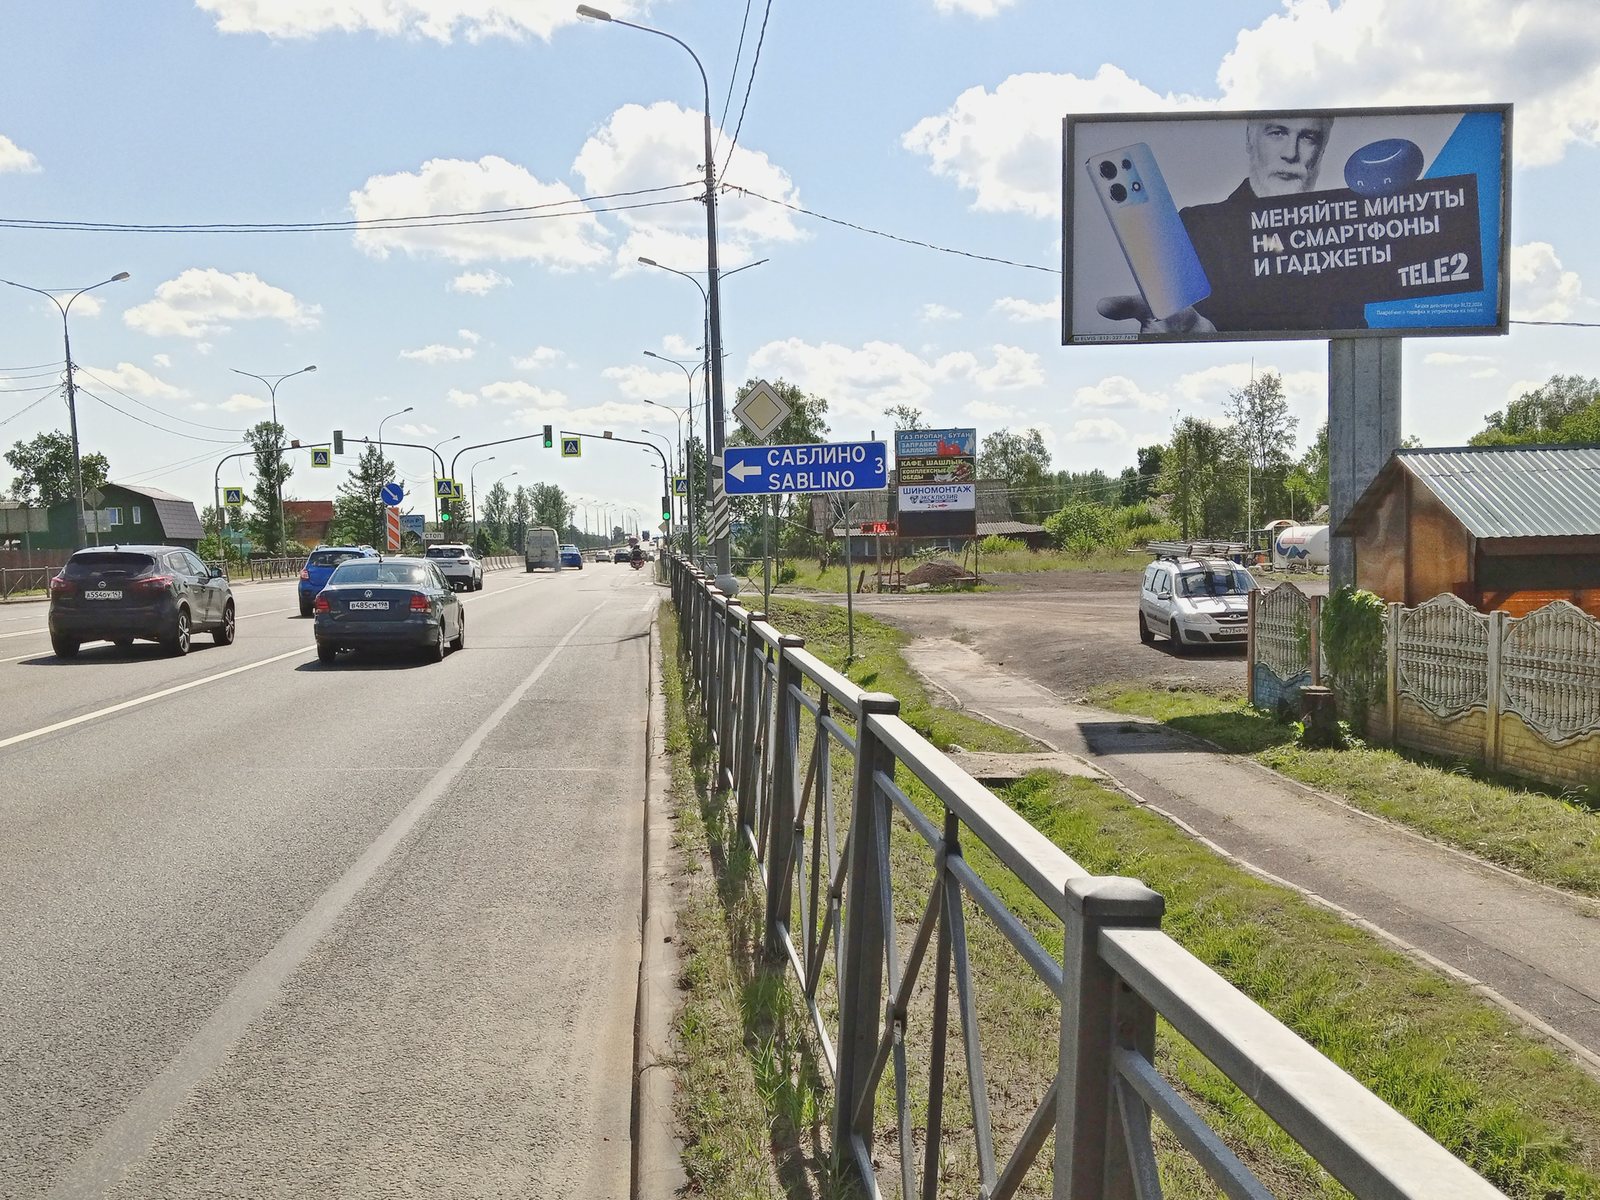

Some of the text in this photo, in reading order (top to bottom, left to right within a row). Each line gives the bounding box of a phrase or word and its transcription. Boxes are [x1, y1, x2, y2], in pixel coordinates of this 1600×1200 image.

[1251, 188, 1465, 230] МЕНЯЙТЕ МИНУТЫ
[1252, 215, 1440, 253] НА СМАРТФОНЫ
[1254, 244, 1391, 277] И ГАДЖЕТЫ
[1398, 252, 1470, 287] TELE2
[767, 445, 866, 466] САБЛИНО
[874, 457, 884, 474] 3
[768, 470, 855, 490] SABLINO
[902, 486, 972, 495] ШИНОМОНТАЖ
[873, 523, 887, 533] ГАЗ
